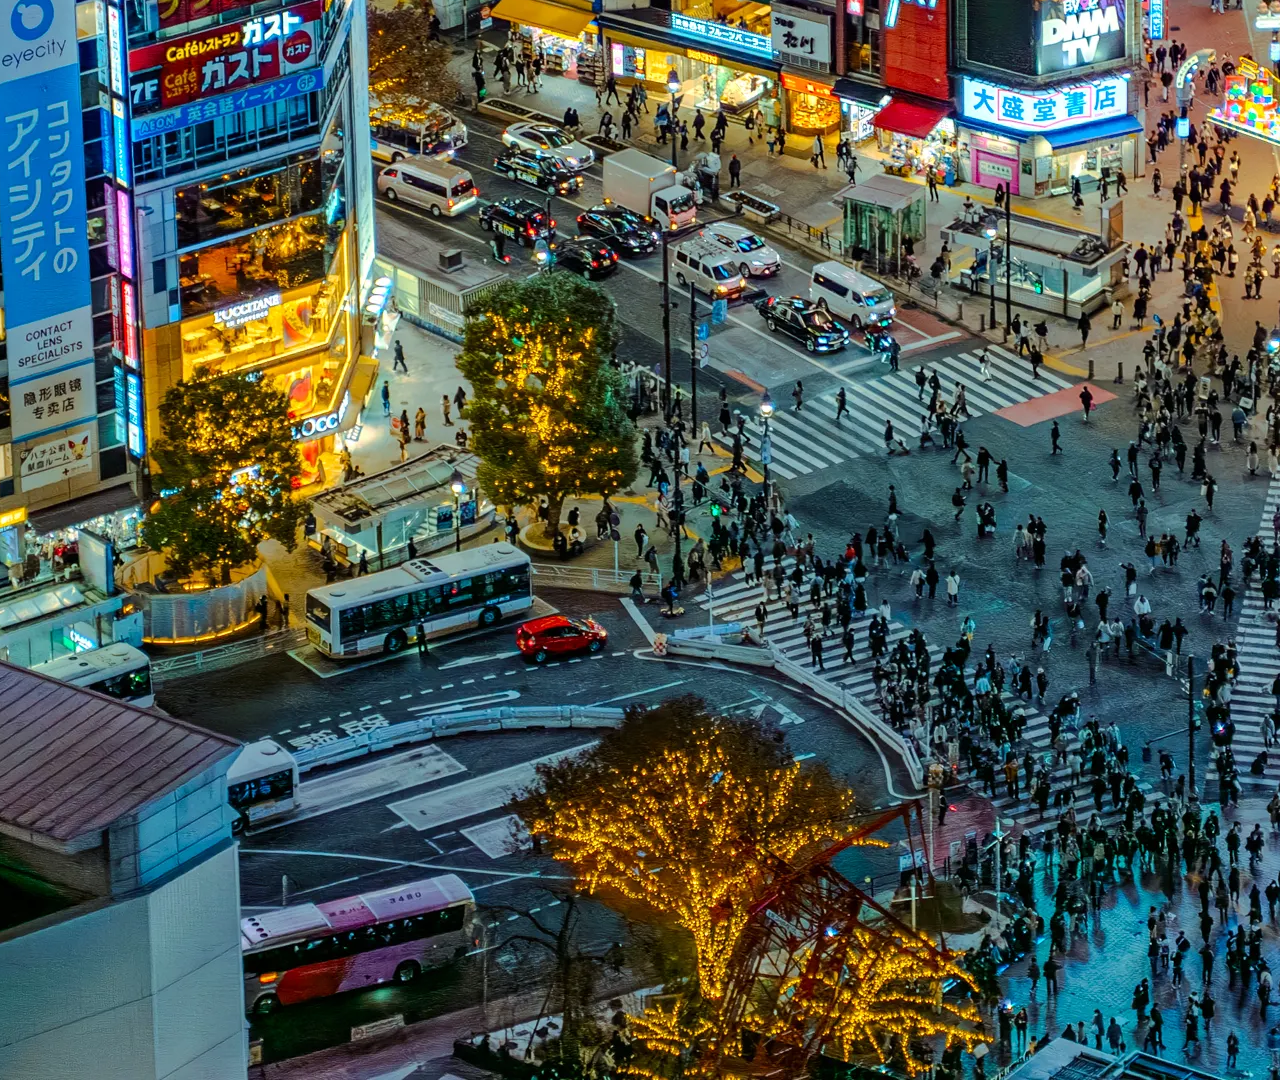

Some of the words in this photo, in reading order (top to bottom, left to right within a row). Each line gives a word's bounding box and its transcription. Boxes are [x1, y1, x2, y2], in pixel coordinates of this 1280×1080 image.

[242, 11, 300, 47] ガスト
[1042, 5, 1121, 46] DMM
[1, 38, 67, 69] eyecity
[286, 43, 310, 58] ガスト
[1062, 35, 1101, 67] TV
[164, 67, 197, 89] Café
[201, 47, 273, 92] ガスト
[130, 78, 159, 105] 7F
[165, 83, 198, 99] レストラン
[973, 84, 1117, 122] 大盛堂書店
[139, 114, 176, 136] AEON
[187, 82, 293, 124] 英会話イーオン
[5, 107, 49, 282] アイシティ
[46, 99, 79, 274] コンタクトの
[213, 293, 281, 324] L'OCCITANE
[25, 320, 73, 342] CONTACT
[37, 335, 63, 351] LENS
[17, 340, 83, 368] SPECIALISTS
[23, 377, 83, 407] 隐形眼镜
[32, 397, 75, 420] 专卖店
